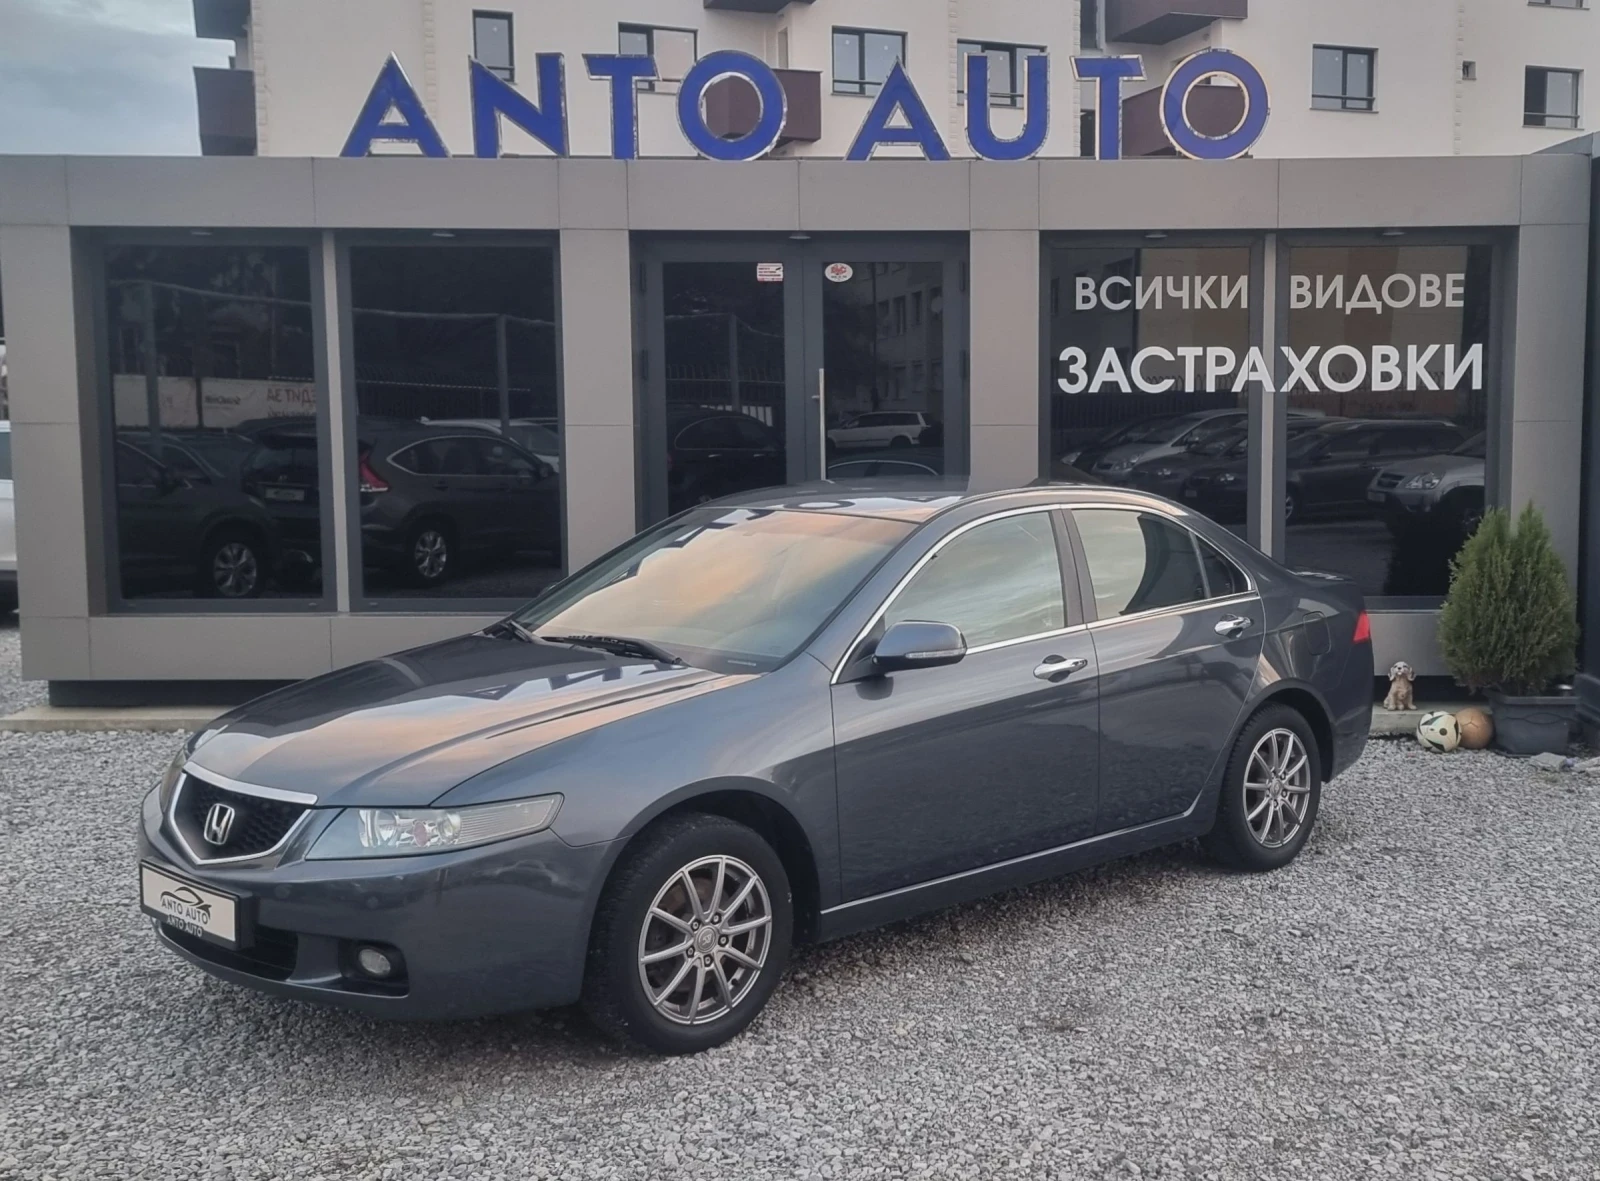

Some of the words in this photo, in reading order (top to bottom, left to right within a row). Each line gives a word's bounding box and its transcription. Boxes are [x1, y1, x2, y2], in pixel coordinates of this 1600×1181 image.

[339, 49, 788, 160] ANTO
[843, 48, 1271, 160] AUTO
[1075, 275, 1249, 310] ВСИЧКИ
[1289, 273, 1465, 314] ВИДОВЕ
[1057, 343, 1483, 393] ЗАСТРАХОВКИ
[161, 898, 183, 915] ANTO
[185, 907, 209, 925] AUTO
[167, 914, 185, 930] ANTO
[184, 922, 203, 938] AUTO
